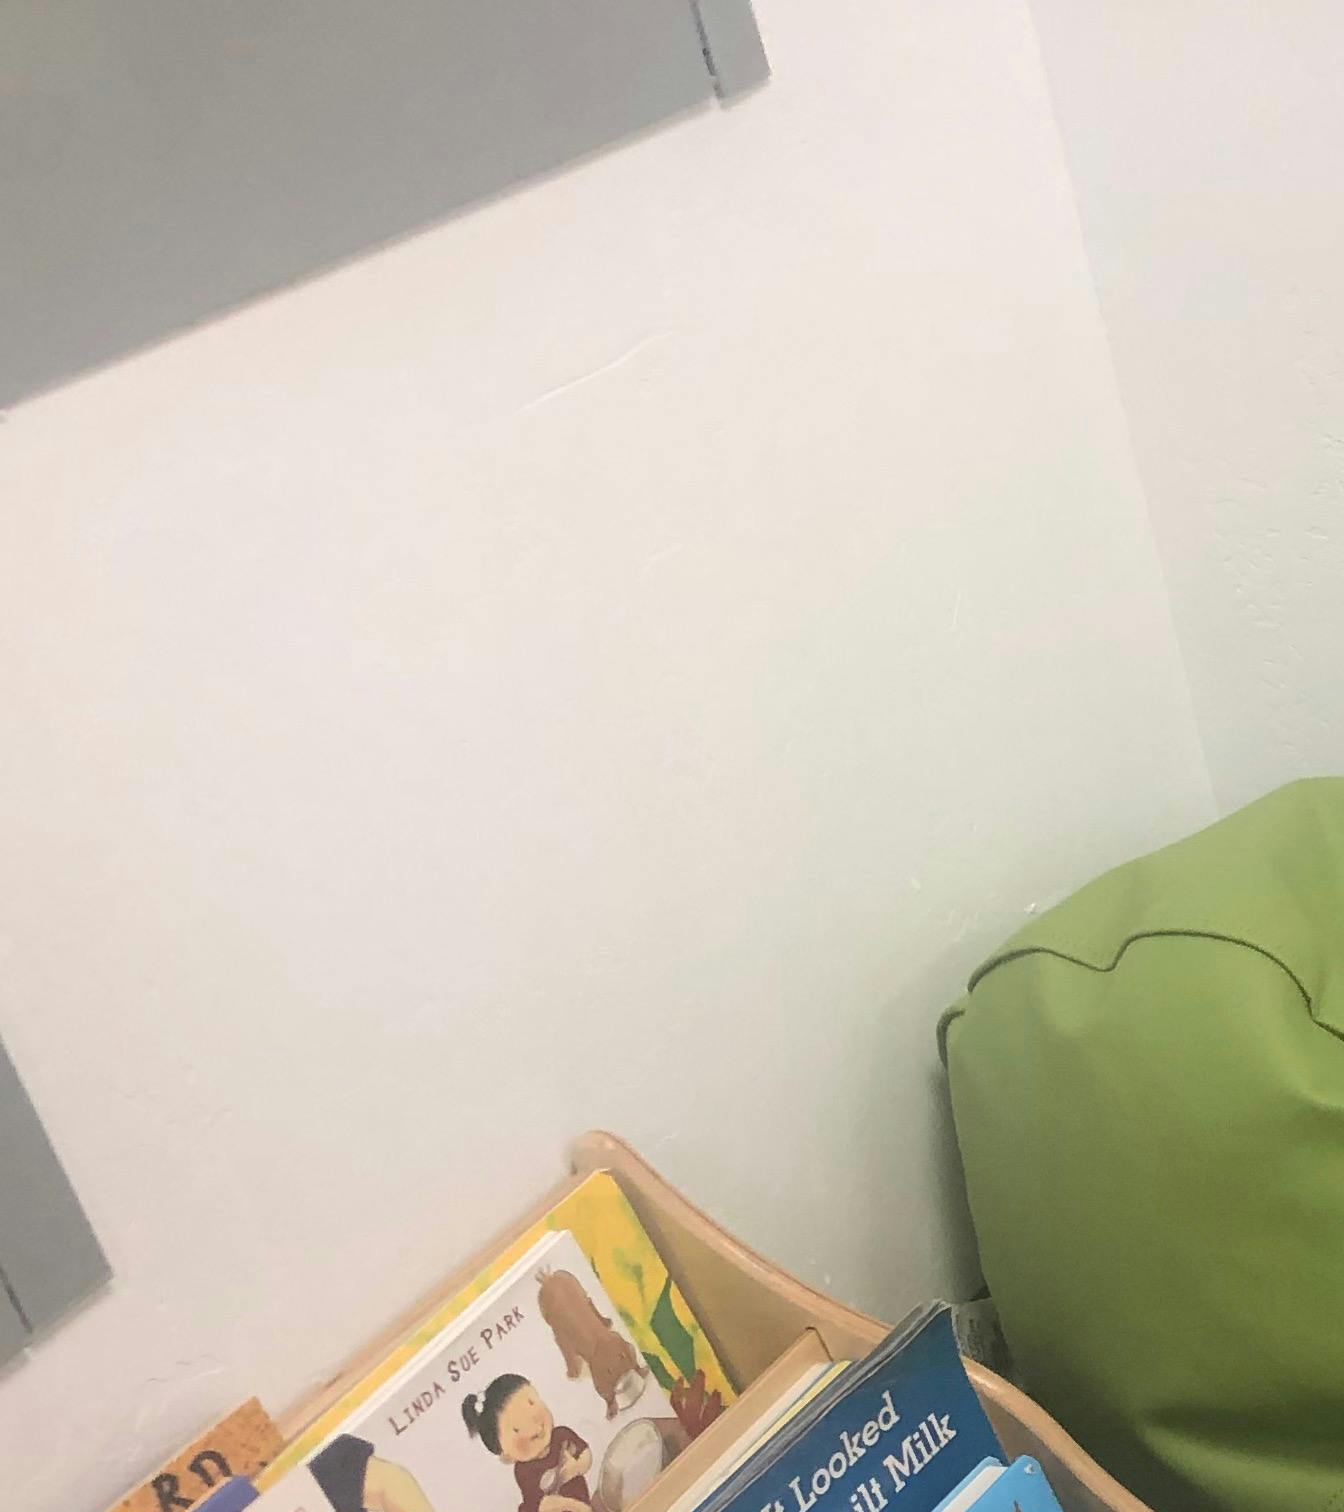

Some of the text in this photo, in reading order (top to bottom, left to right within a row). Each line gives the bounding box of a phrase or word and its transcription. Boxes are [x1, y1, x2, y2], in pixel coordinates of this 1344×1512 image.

[388, 1306, 525, 1436] LINDA SUE PARK
[882, 1411, 957, 1494] Milk
